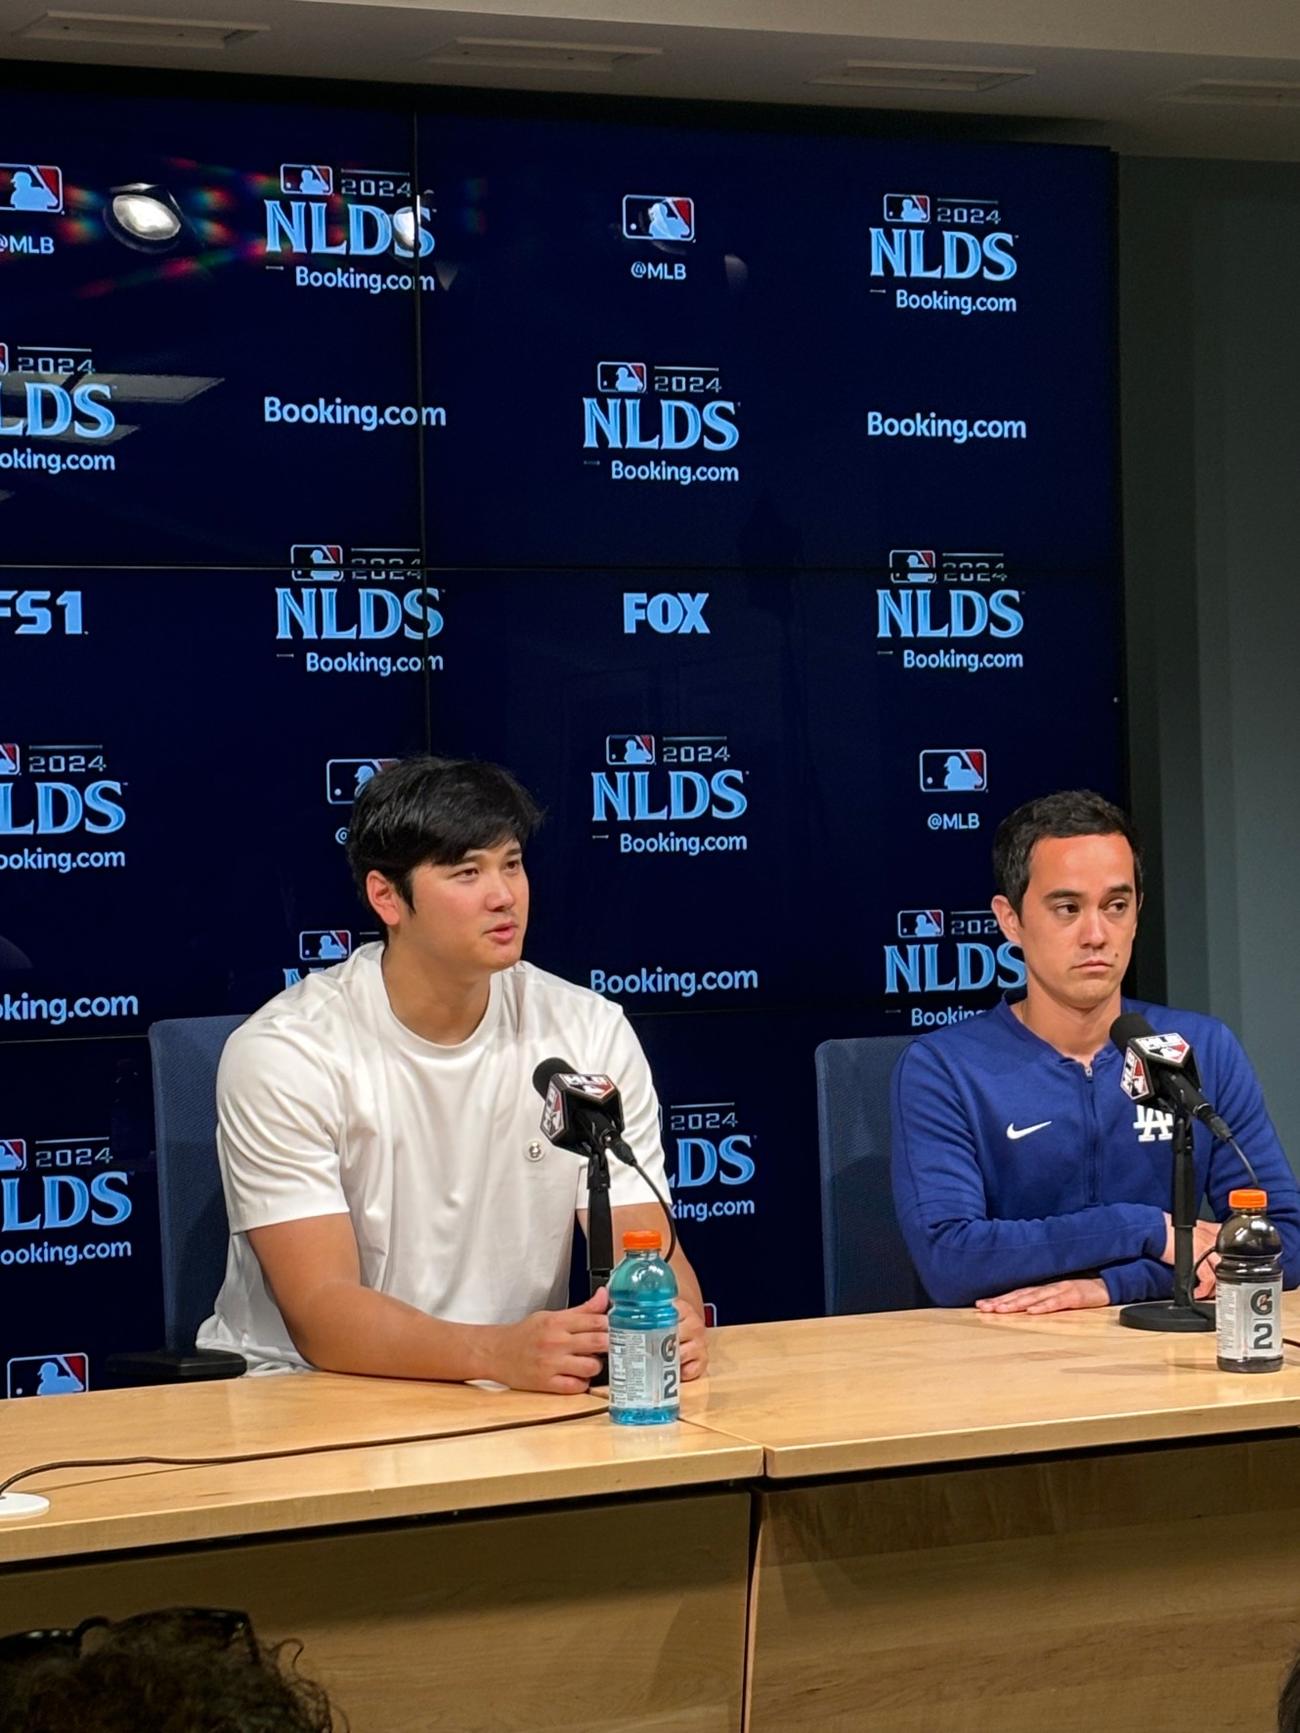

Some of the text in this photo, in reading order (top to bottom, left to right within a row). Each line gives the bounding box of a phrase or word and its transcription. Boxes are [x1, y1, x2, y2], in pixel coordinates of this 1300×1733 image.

[341, 179, 411, 198] 2024
[264, 199, 435, 258] NLDS
[937, 208, 1001, 224] 2024
[869, 227, 1017, 281] NLDS
[296, 266, 435, 294] Booking.com
[631, 261, 686, 280] @MLB
[896, 289, 1016, 315] Booking.com
[18, 358, 95, 376] 2024
[655, 376, 722, 393] 2024
[264, 396, 446, 431] Booking.com
[583, 397, 739, 451] NLDS
[868, 411, 1026, 444] Booking.com
[611, 460, 739, 485] Booking.com
[352, 558, 420, 580] 2024
[943, 563, 1007, 581] 2024
[275, 587, 444, 640] NLDS
[623, 592, 710, 634] FOX
[876, 589, 1024, 638] NLDS
[306, 651, 443, 677] Booking.com
[904, 649, 1023, 672] Booking.com
[29, 755, 106, 773] 2024
[663, 746, 730, 762] 2024
[0, 780, 126, 834] LDS
[591, 769, 747, 821] NLDS
[928, 813, 980, 830] @MLB
[620, 832, 747, 856] Booking.com
[951, 919, 998, 935] 202
[884, 942, 1028, 993] NLDS
[590, 967, 758, 997] Booking.com
[0, 992, 138, 1025] king.com
[912, 1006, 987, 1026] Bookin
[671, 1112, 738, 1130] 2024
[1133, 1104, 1173, 1142] LA
[36, 1147, 113, 1167] 2024
[668, 1134, 755, 1188] DS
[1, 1171, 132, 1232] LDS
[0, 1241, 131, 1265] ooking.com
